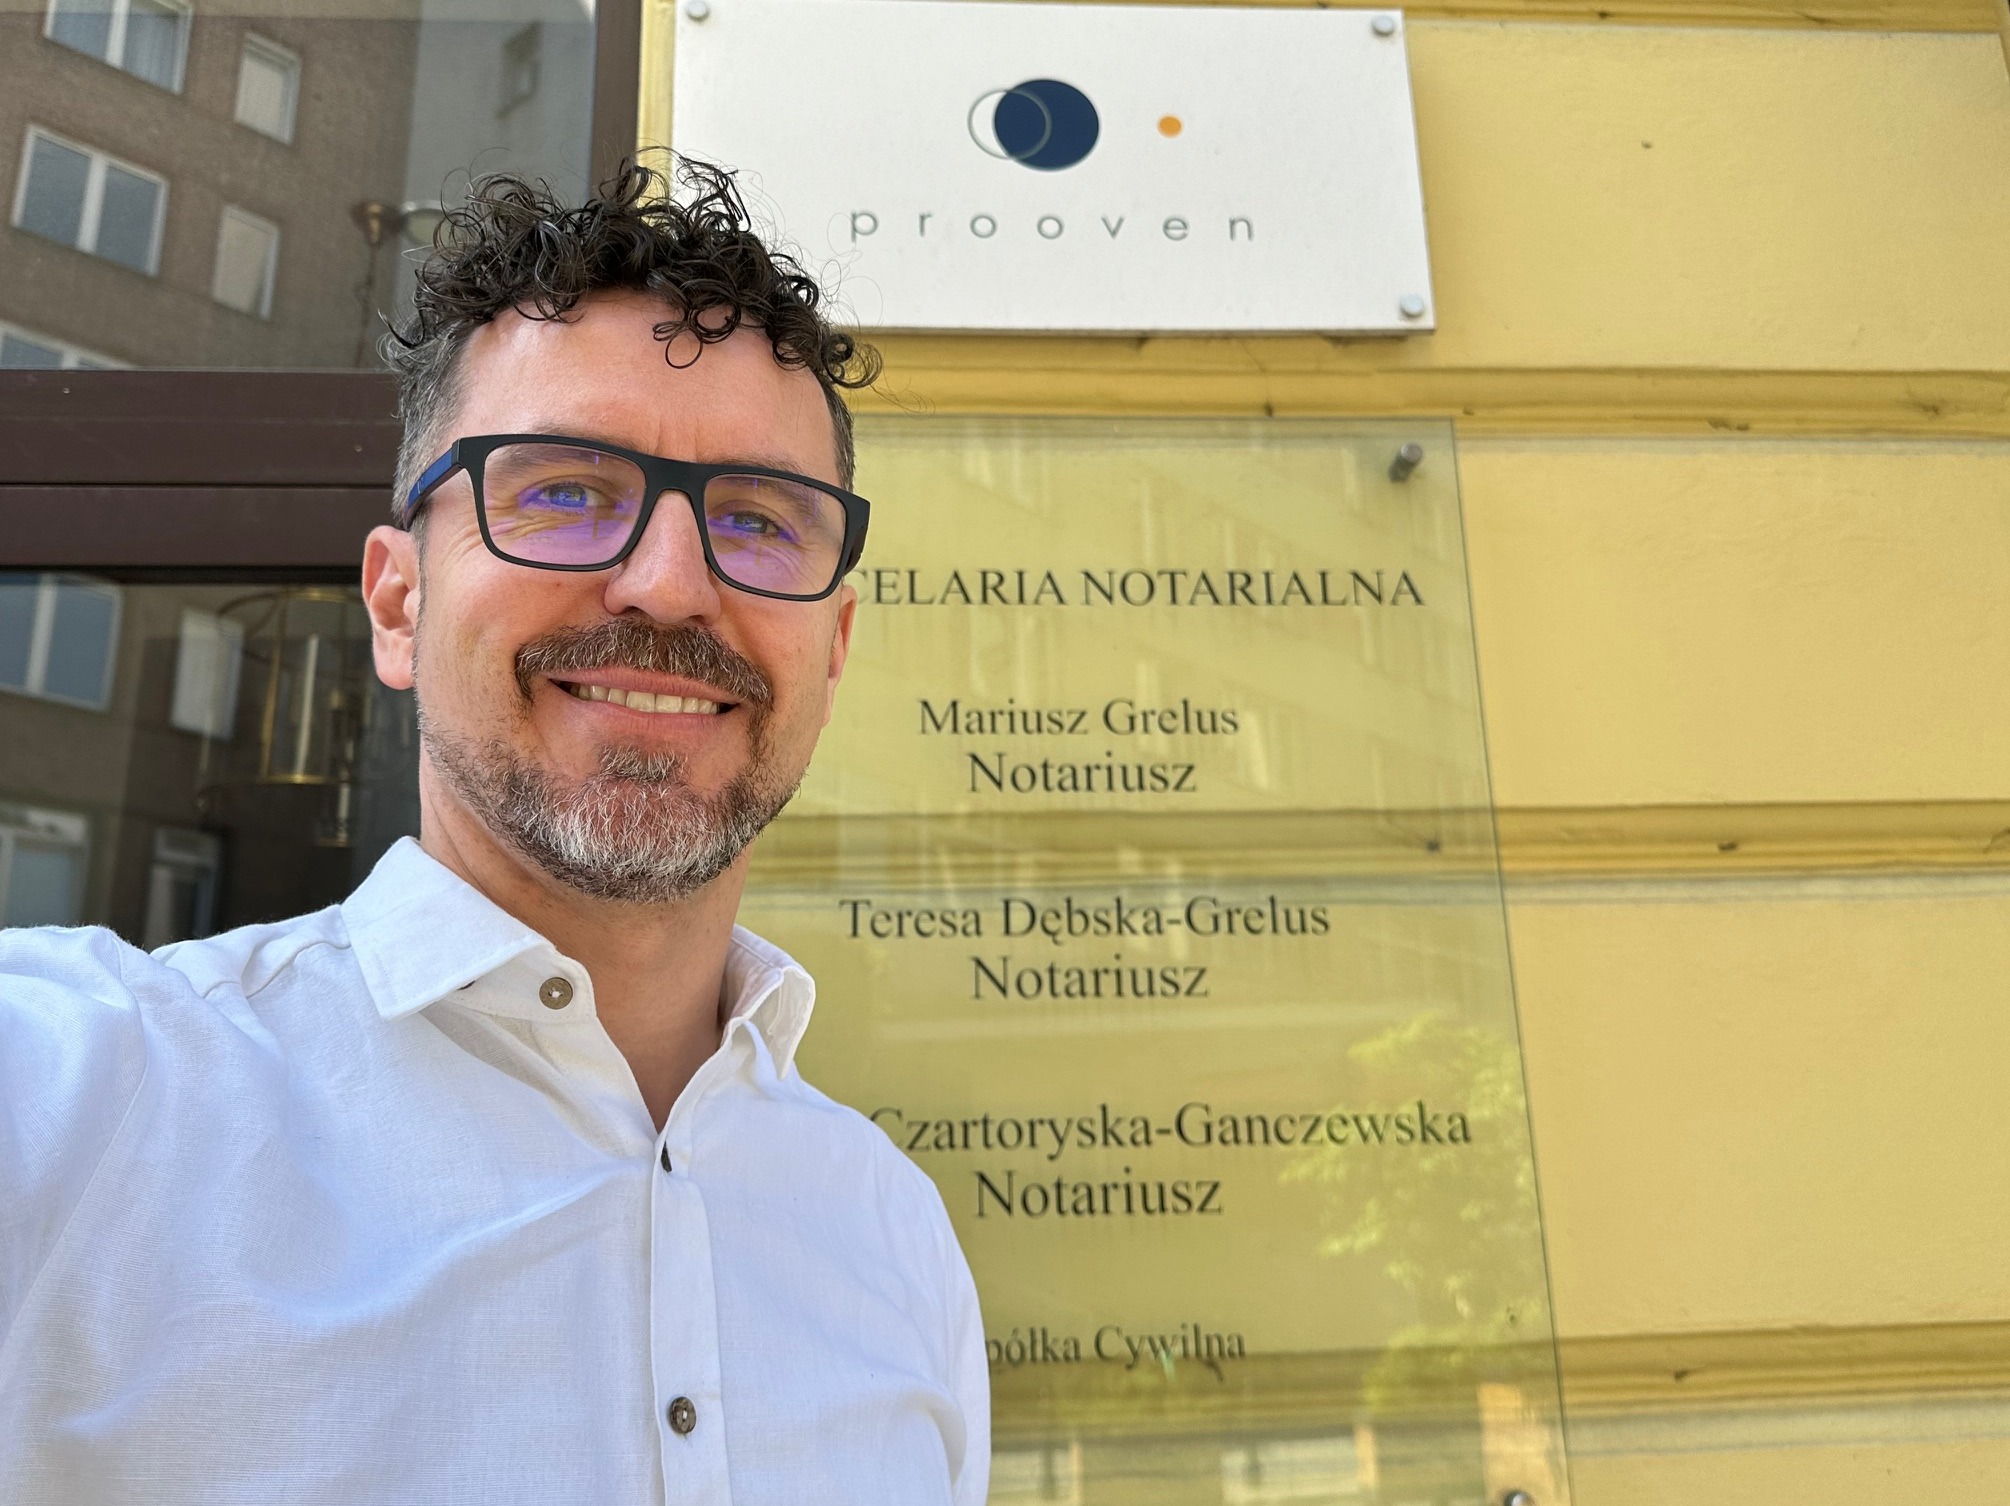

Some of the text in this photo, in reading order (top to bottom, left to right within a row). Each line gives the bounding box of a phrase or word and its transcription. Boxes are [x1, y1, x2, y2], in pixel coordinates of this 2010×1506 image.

[850, 208, 1255, 243] prooven
[1080, 568, 1425, 607] NOTARIALNA
[918, 697, 1241, 737] Mariusz Grelus
[968, 751, 1197, 795] Notariusz
[839, 895, 1332, 945] Teresa Dębska-Grelus
[970, 954, 1212, 1000] Notariusz
[974, 1168, 1225, 1218] Notariusz
[1094, 1323, 1246, 1370] Cywilna
